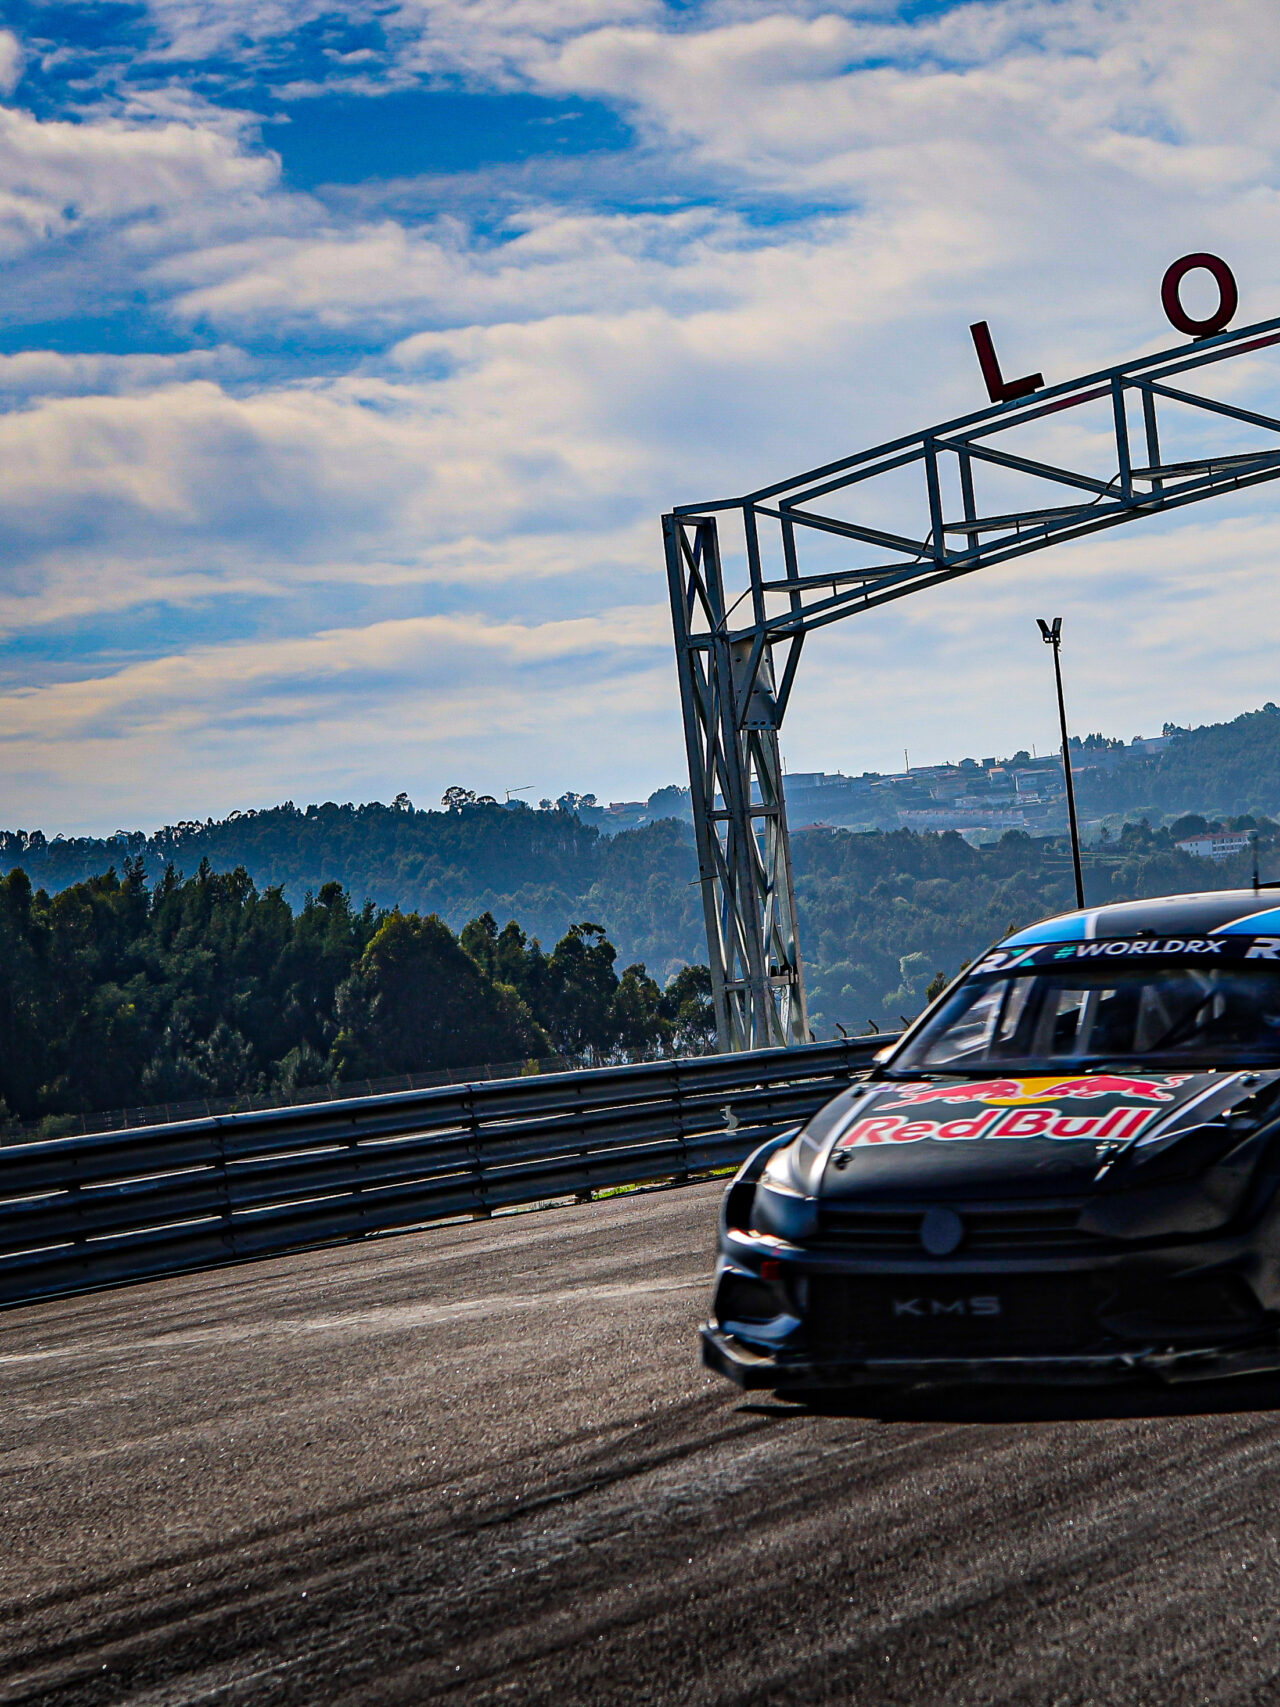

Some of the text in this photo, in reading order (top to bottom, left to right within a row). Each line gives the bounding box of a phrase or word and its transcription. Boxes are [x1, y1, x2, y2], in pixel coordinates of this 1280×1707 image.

[1053, 940, 1228, 960] #WORLDRX
[834, 1107, 1162, 1149] Red Bull
[894, 1296, 1001, 1316] KMS
